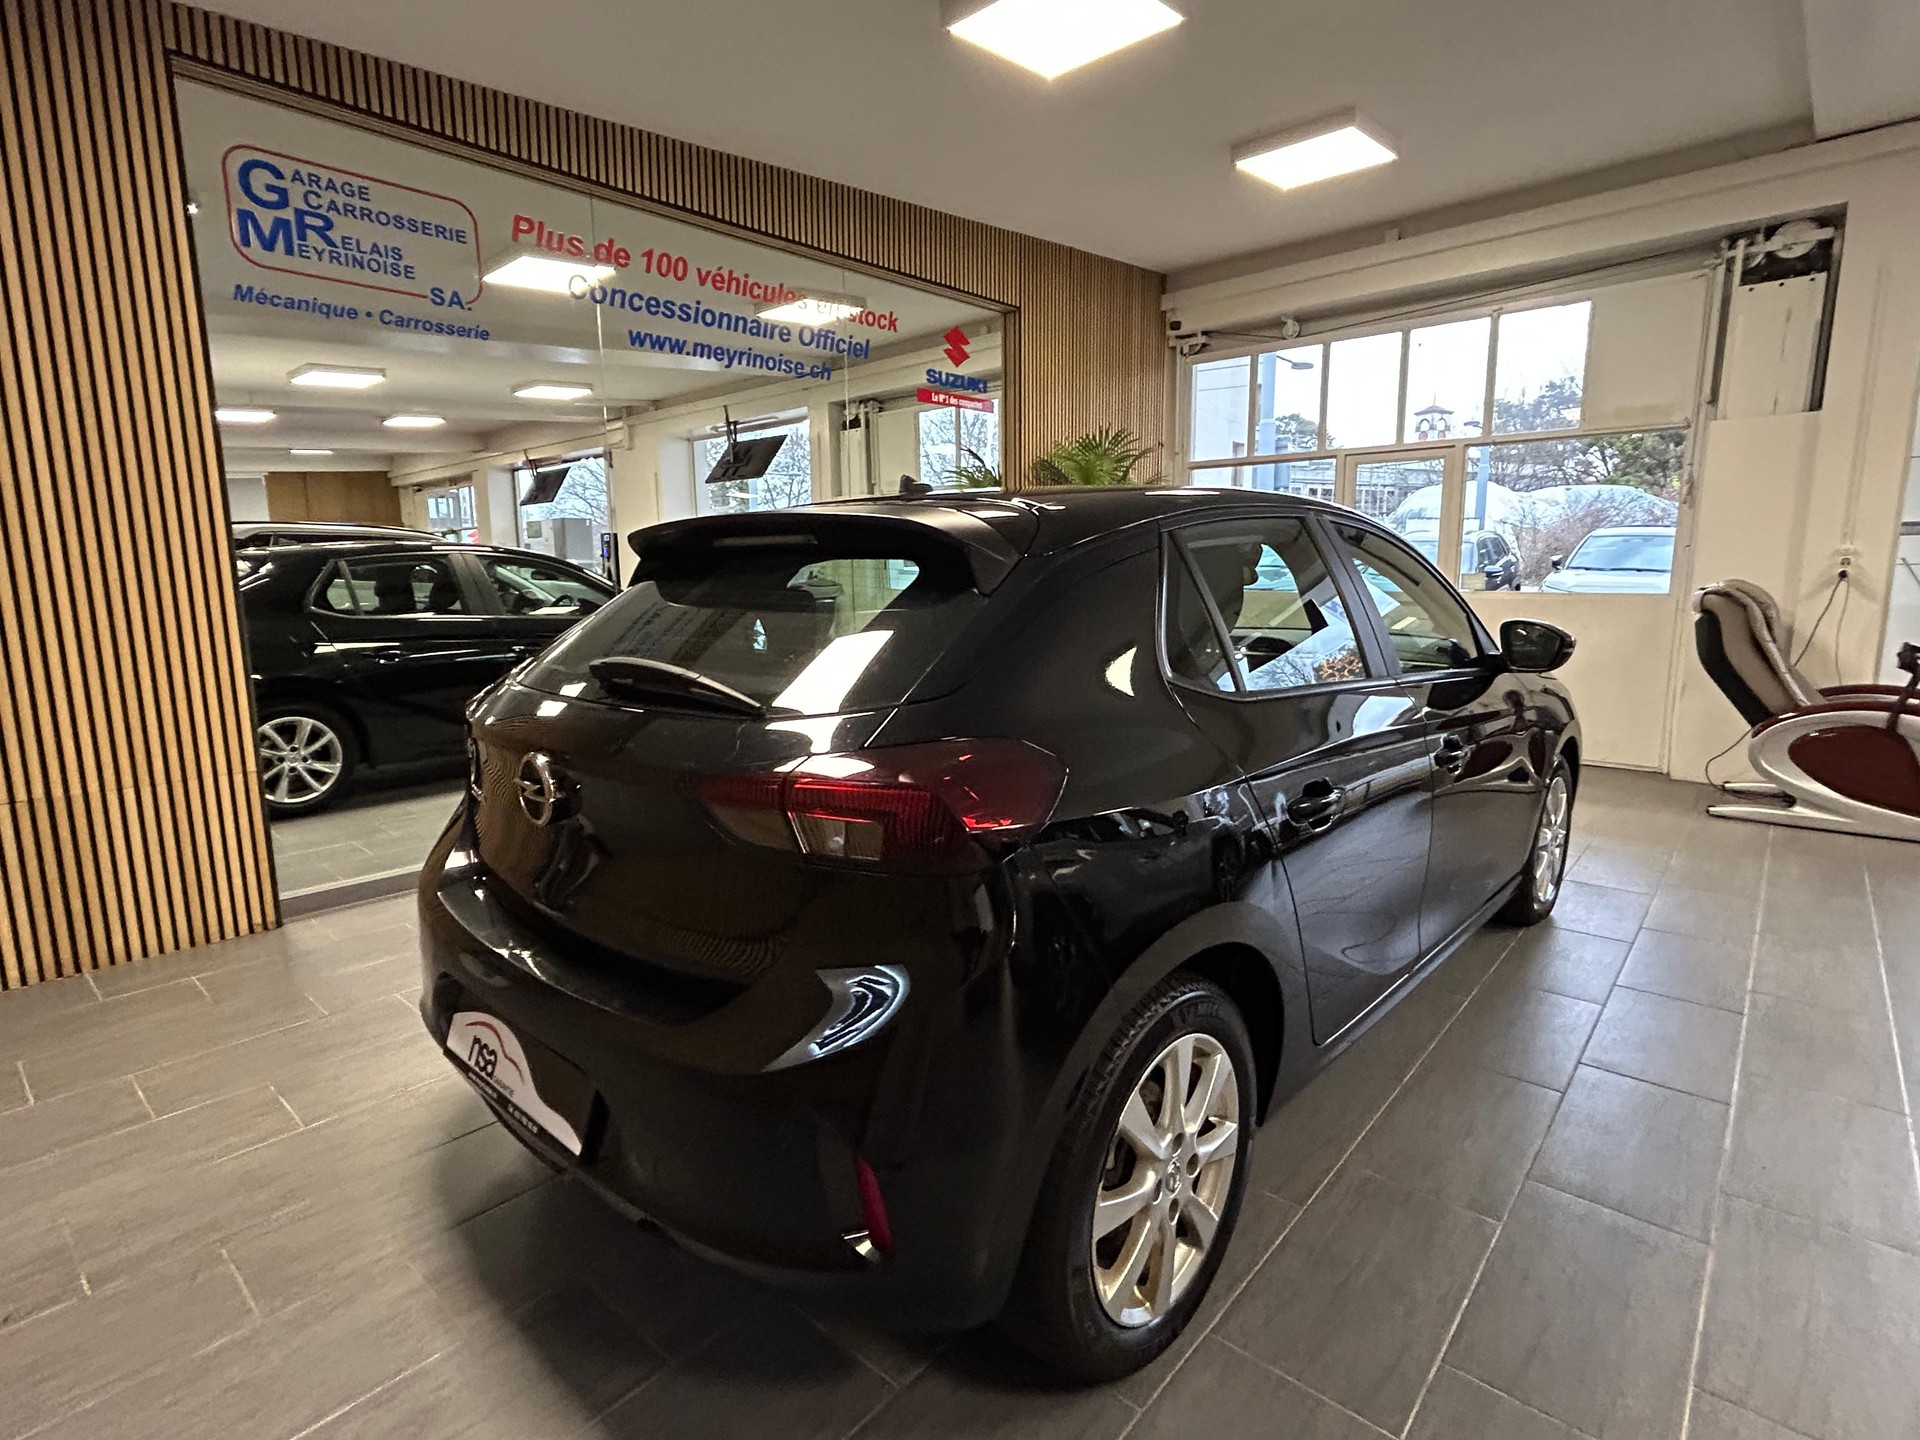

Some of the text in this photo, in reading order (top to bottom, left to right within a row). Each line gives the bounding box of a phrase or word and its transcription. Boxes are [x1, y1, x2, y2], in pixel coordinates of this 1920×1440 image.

[238, 159, 371, 211] GARAGE
[236, 207, 416, 280] MEYRINOISE
[294, 207, 404, 262] RELAIS
[304, 190, 468, 245] CARROSSERIE
[511, 214, 585, 257] Plus
[593, 238, 631, 269] de
[641, 248, 689, 281] 100
[233, 284, 491, 341] Mécanique Carrosserie
[568, 274, 871, 360] Concessionnaire Officiel
[628, 327, 834, 381] www.meyrinoise.ch
[926, 368, 988, 394] SUZUKI
